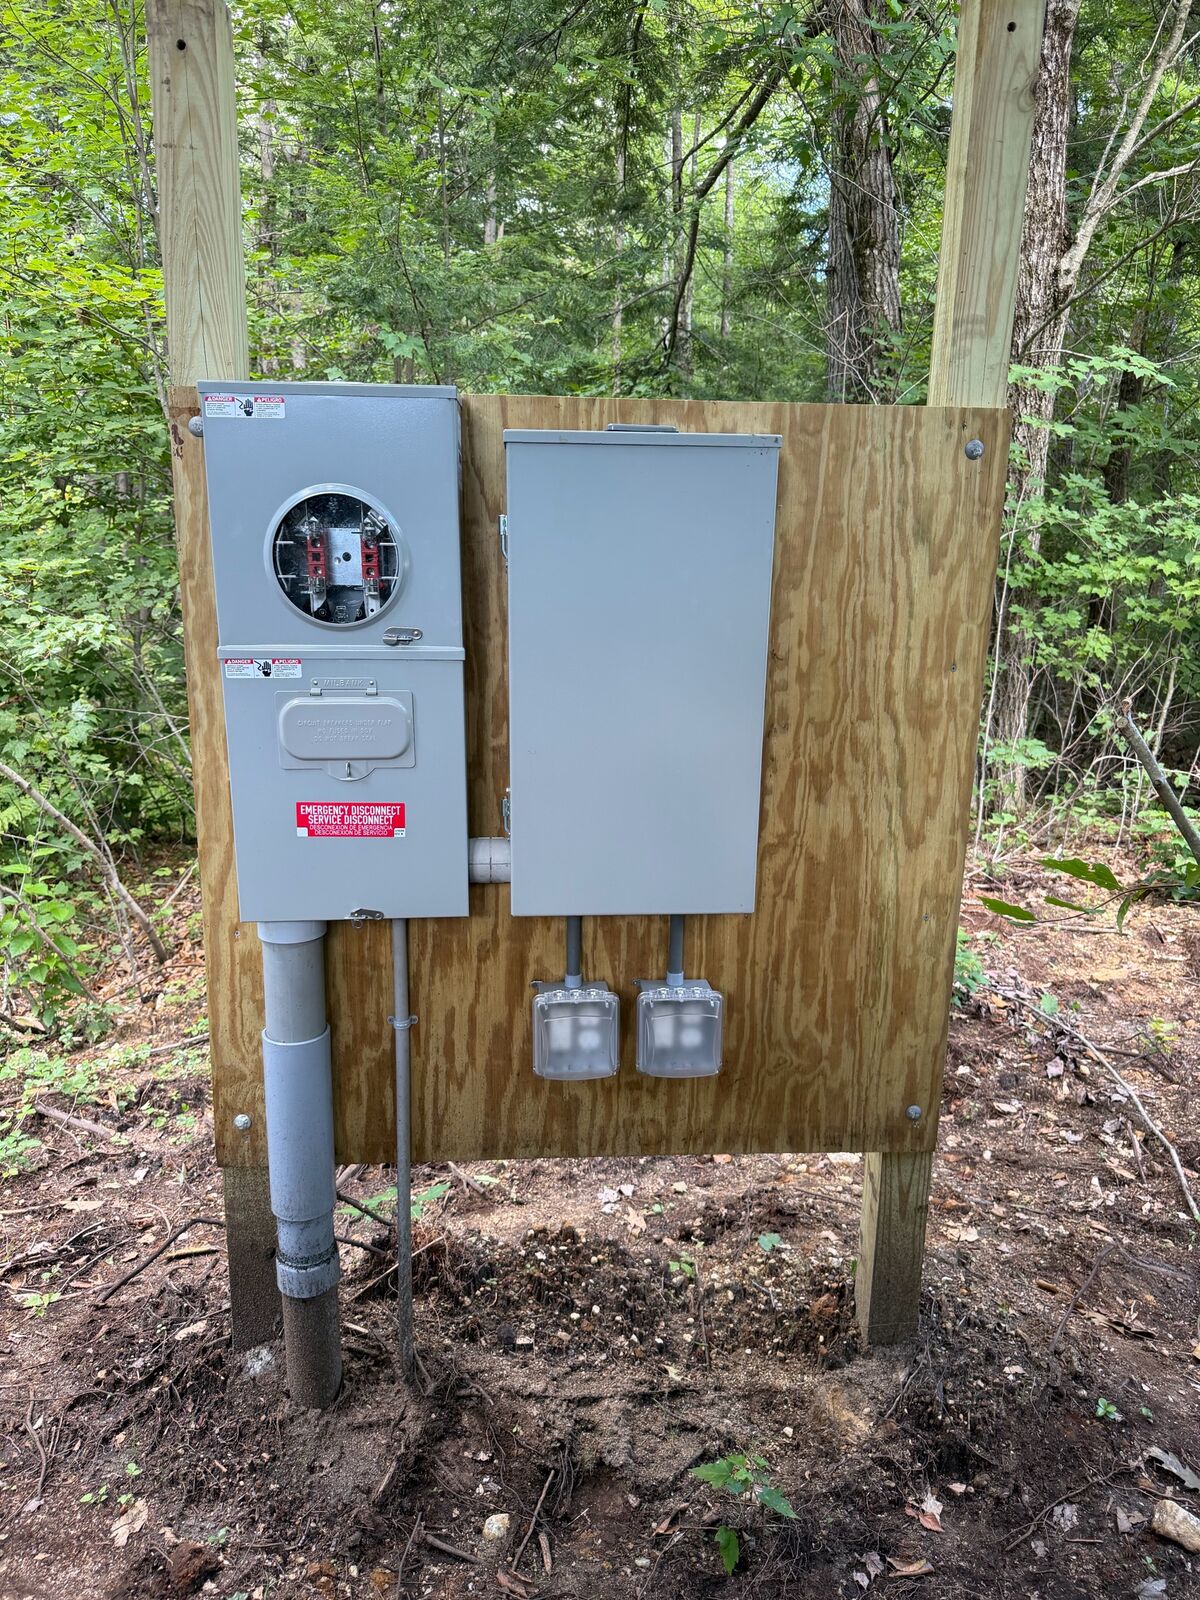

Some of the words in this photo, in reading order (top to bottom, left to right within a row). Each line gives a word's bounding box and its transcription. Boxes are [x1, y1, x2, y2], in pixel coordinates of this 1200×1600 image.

[300, 805, 349, 815] EMERGENCY
[351, 805, 401, 816] DISCONNECT
[308, 815, 342, 825] SERVICE
[344, 815, 394, 825] DISCONNECT
